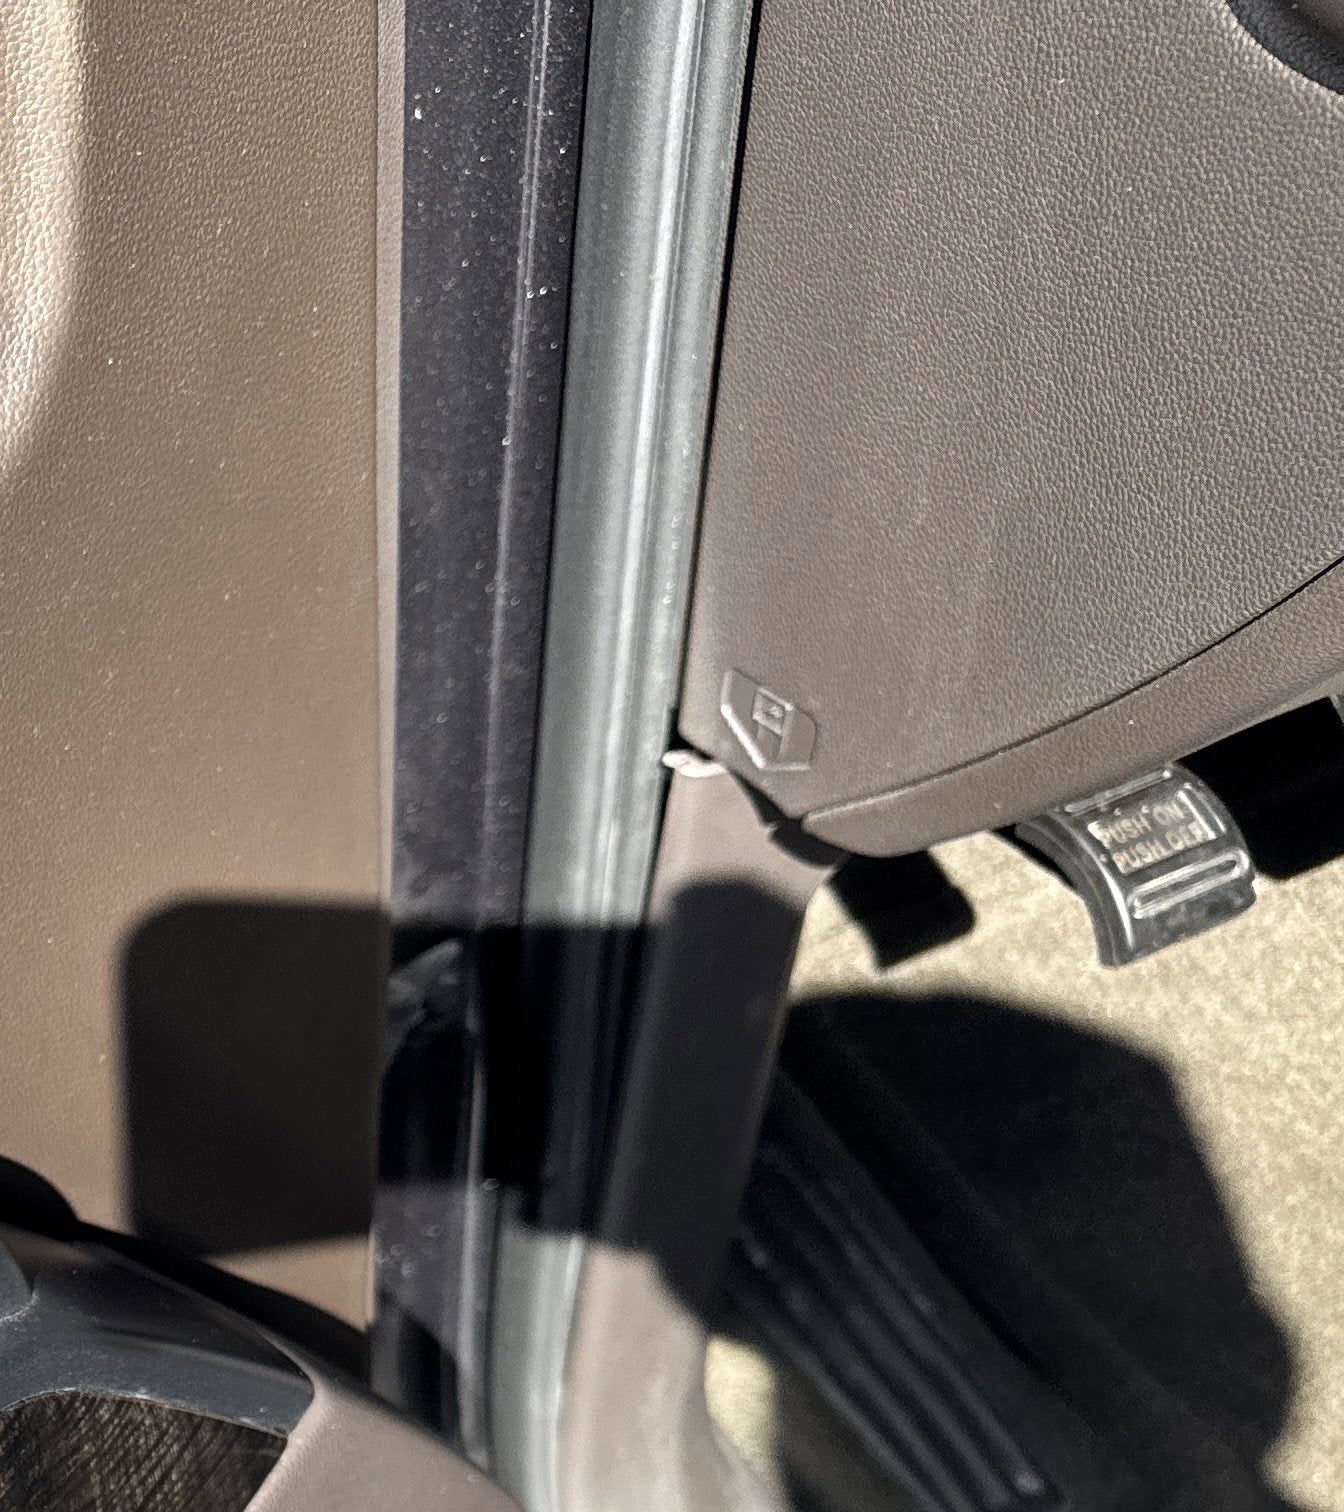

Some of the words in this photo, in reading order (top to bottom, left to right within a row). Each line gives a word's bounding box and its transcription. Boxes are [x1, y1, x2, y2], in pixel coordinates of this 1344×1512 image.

[1098, 812, 1153, 850] PUSH
[1153, 800, 1185, 827] ON
[1112, 839, 1167, 874] PUSH
